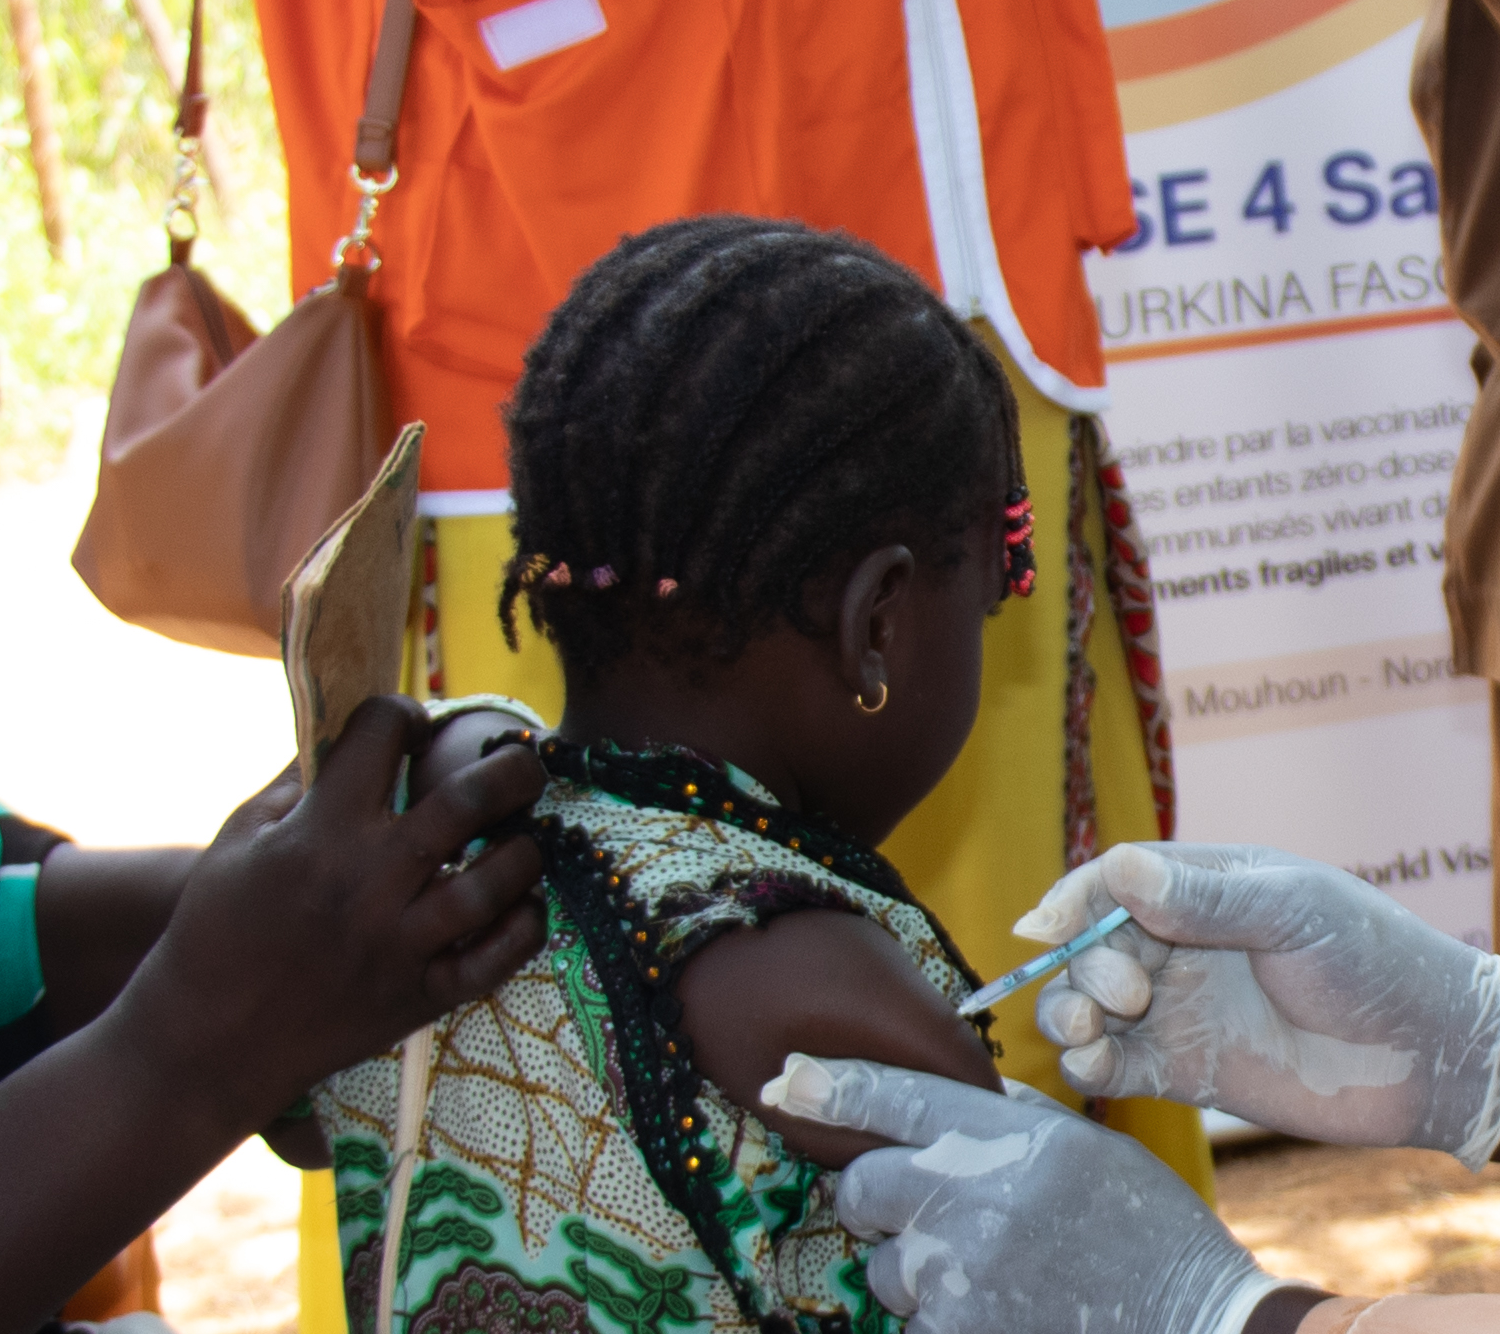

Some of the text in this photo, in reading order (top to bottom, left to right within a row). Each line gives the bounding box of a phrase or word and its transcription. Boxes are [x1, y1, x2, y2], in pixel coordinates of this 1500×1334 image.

[1242, 160, 1296, 234] 4
[1225, 427, 1275, 462] par
[1285, 421, 1313, 447] la
[1174, 471, 1292, 508] enfants
[1322, 496, 1412, 534] vivant
[1258, 549, 1377, 587] fragiles
[1386, 540, 1416, 566] et
[1184, 672, 1349, 717] Mouhoun
[1343, 848, 1430, 887] orld
